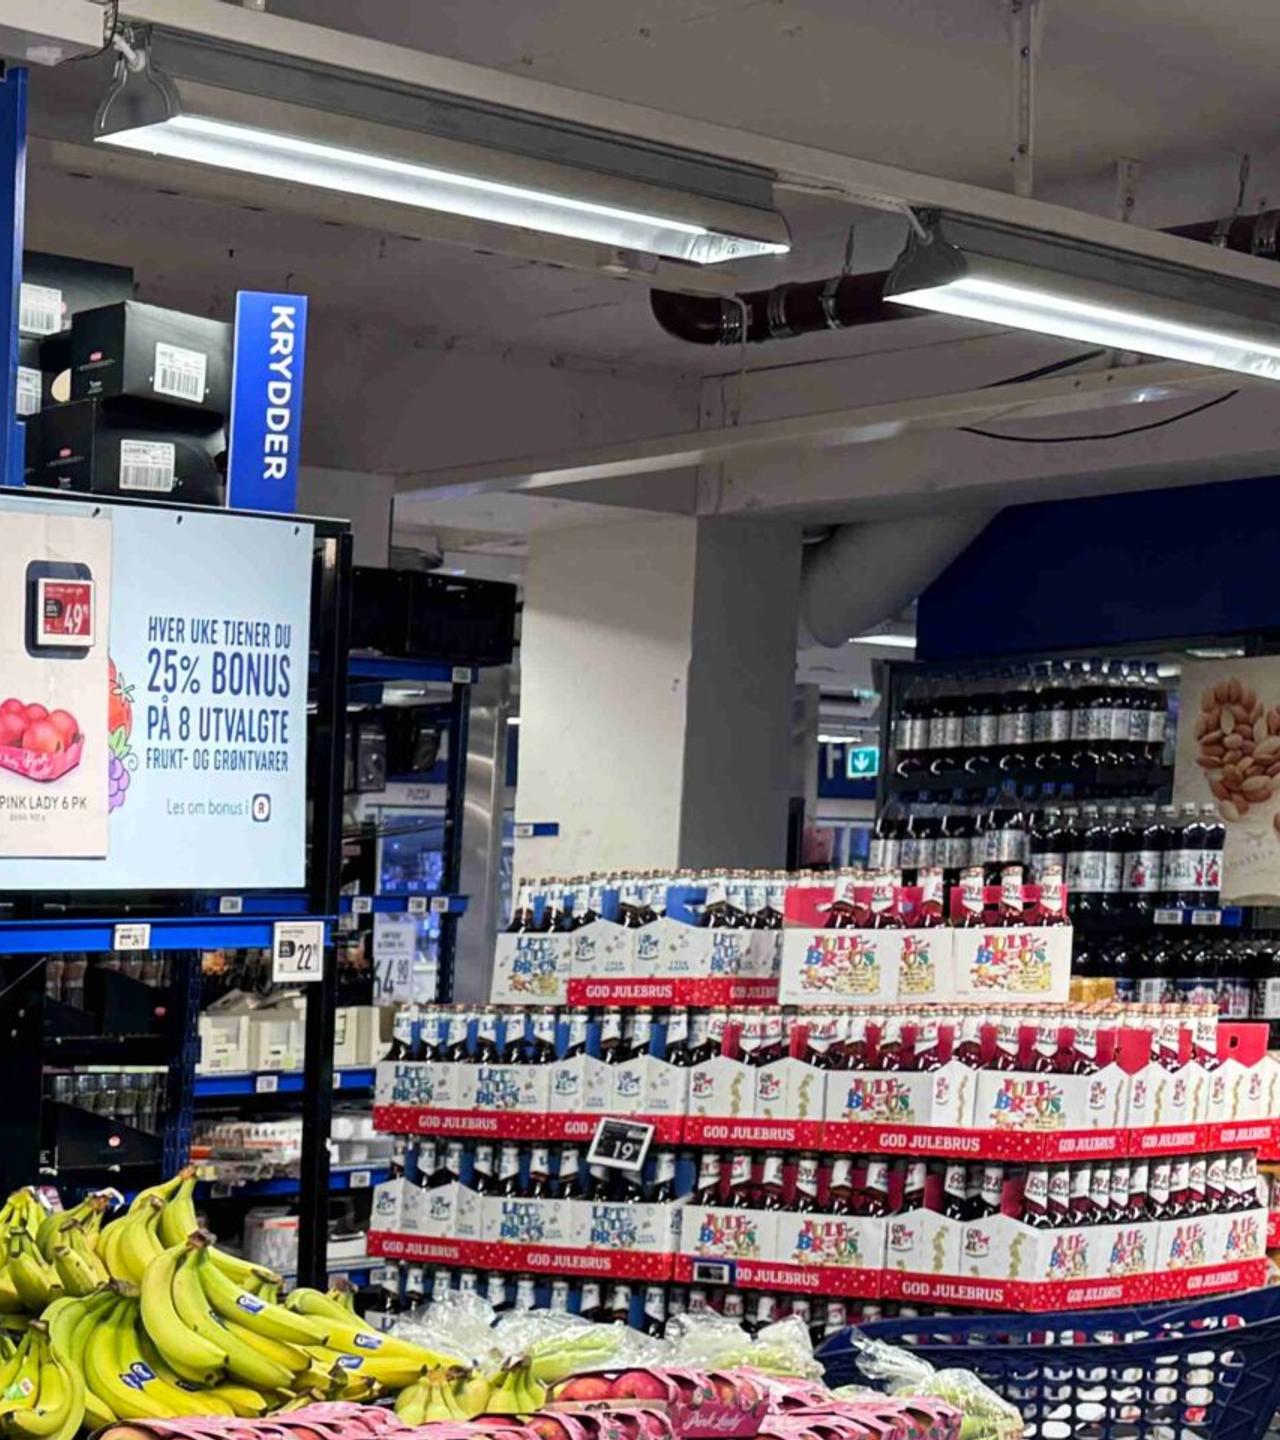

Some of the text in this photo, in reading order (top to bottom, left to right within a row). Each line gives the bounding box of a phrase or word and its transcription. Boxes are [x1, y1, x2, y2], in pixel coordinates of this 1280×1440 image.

[263, 305, 296, 481] KRYDDER
[64, 603, 80, 635] 49
[148, 616, 292, 649] HVER UKE TJENER DU
[147, 647, 291, 698] 25% BONUS
[147, 694, 289, 744] PÅ 8 UTVALGTE
[146, 747, 289, 772] FRUKT- OG GRØNTVARER
[0, 794, 27, 810] PINK
[29, 795, 58, 811] LADY
[61, 796, 69, 810] 6
[70, 796, 87, 810] PK
[167, 799, 186, 815] Les
[187, 803, 206, 815] om
[208, 799, 242, 816] bonus
[297, 944, 312, 971] 22
[586, 985, 672, 998] GOD JULEBRUS
[418, 1116, 497, 1130] GOD JULEBRUS
[565, 1121, 589, 1134] GOD
[703, 1125, 795, 1141] GOD JULEBRUS
[879, 1133, 981, 1151] GOD JULEBRUS
[611, 1140, 634, 1161] 19
[383, 1239, 460, 1259] GOD JULEBRUS
[527, 1253, 611, 1270] GOD JULEBRUS
[736, 1267, 820, 1286] OD JULEBRUS
[902, 1281, 1004, 1301] GOD JULEBRUS
[682, 1411, 746, 1430] Pink Lady
